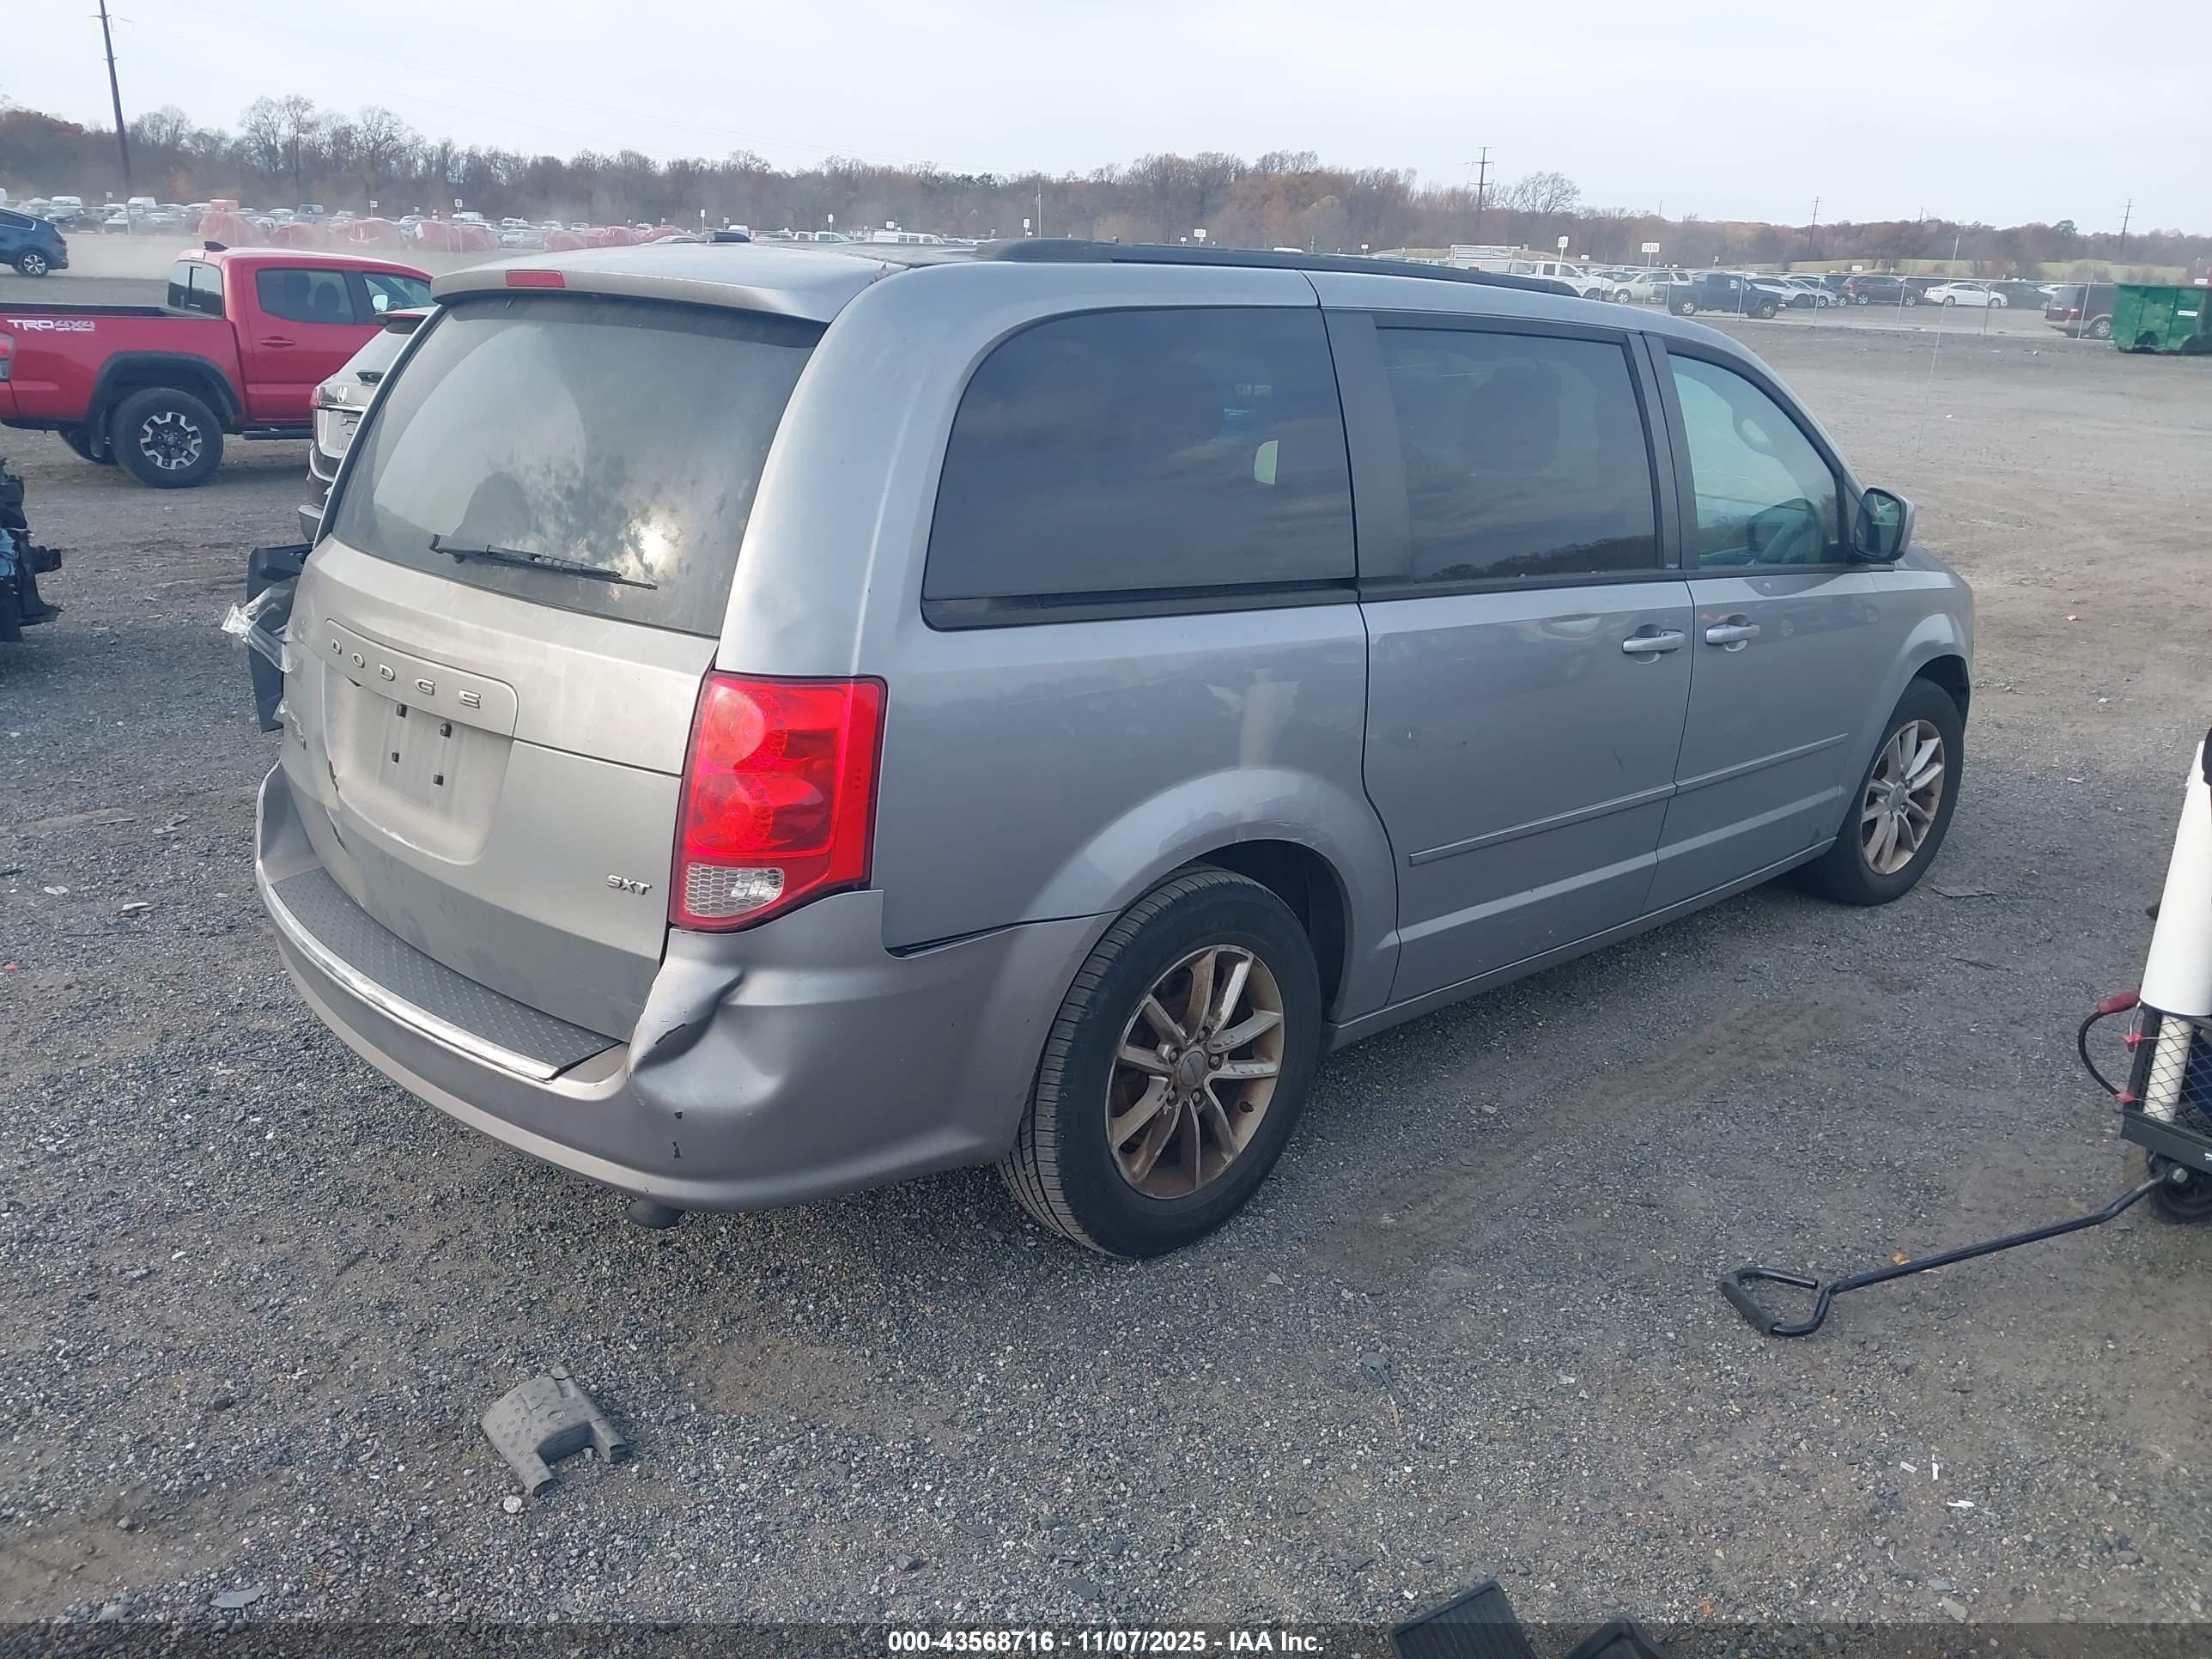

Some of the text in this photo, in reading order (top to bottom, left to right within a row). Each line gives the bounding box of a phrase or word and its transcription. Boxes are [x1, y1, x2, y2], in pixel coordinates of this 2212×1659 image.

[7, 319, 54, 331] TRD
[331, 638, 481, 708] DODGE
[605, 874, 653, 895] SXT
